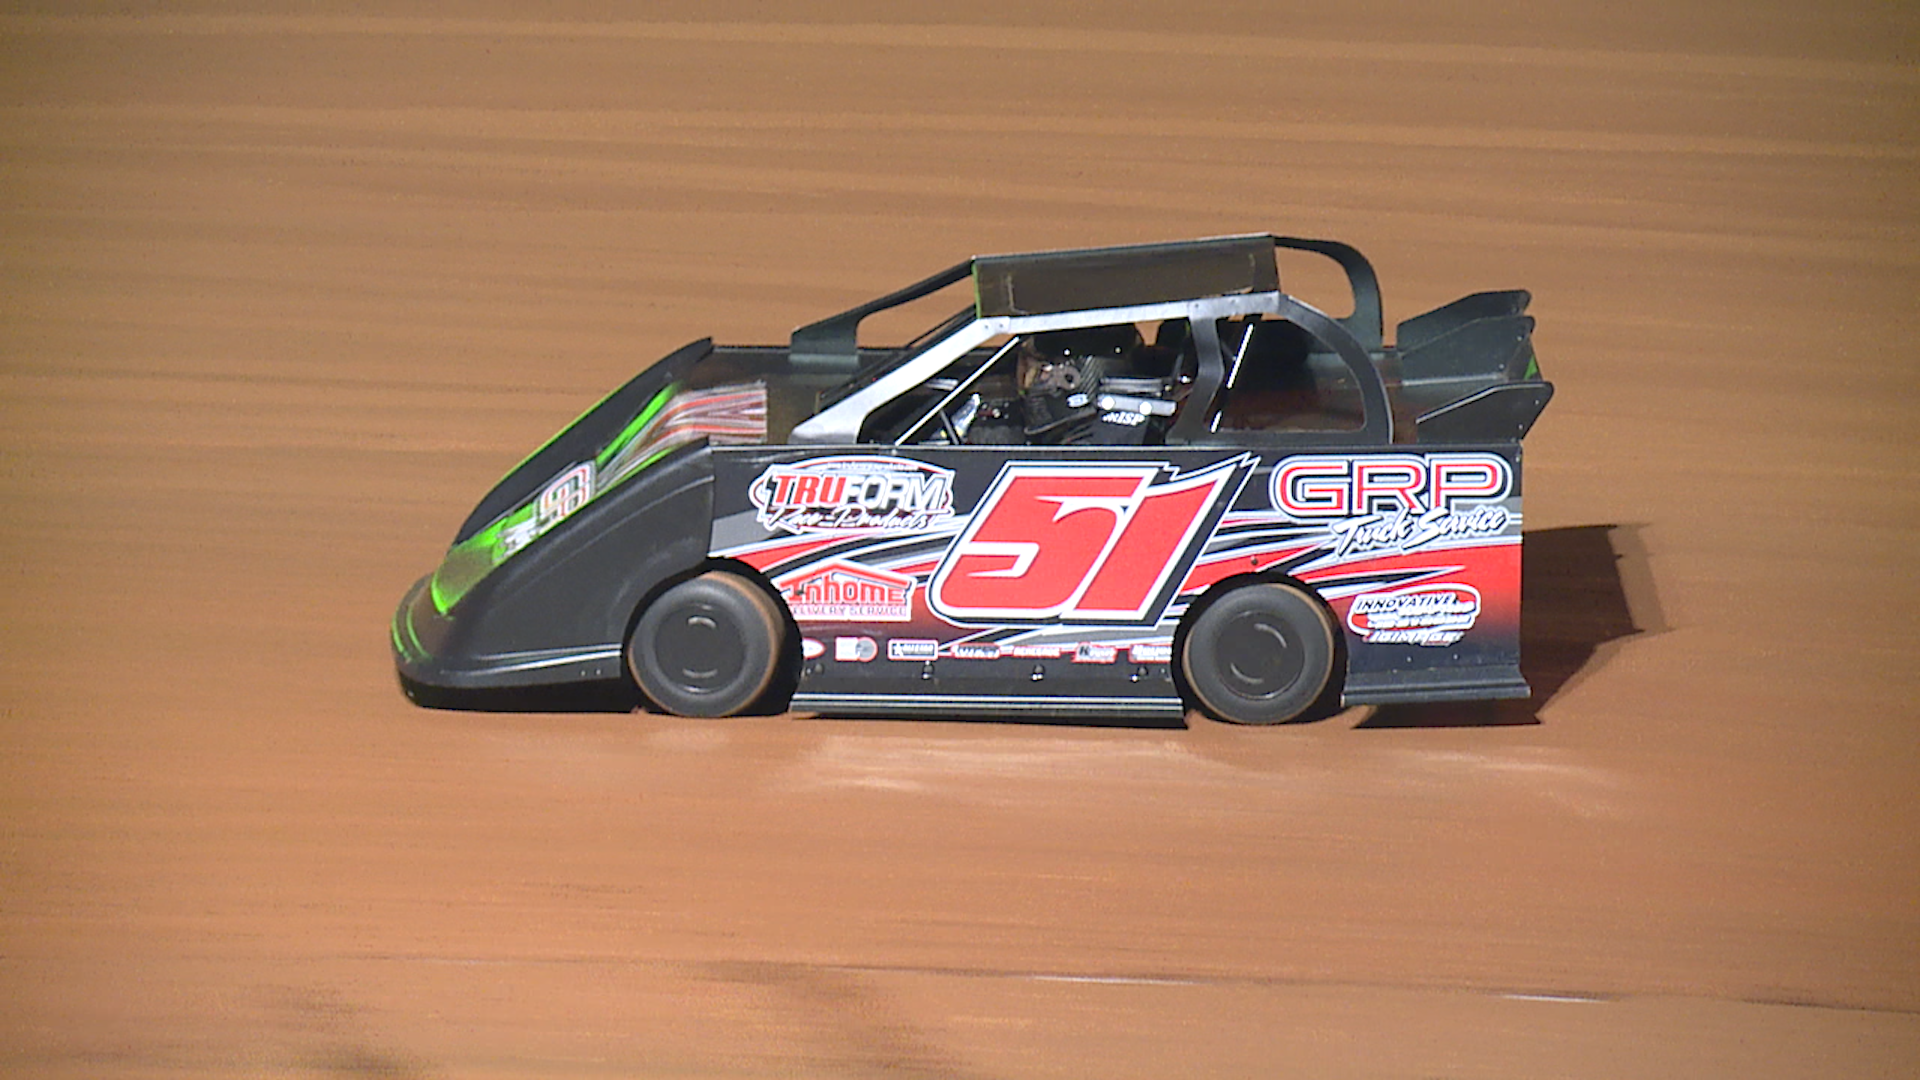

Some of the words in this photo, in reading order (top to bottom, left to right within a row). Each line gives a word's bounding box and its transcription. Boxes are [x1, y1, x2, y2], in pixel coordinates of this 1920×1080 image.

[773, 474, 948, 510] TRUFORM
[1273, 457, 1503, 517] GRP
[831, 504, 931, 529] Products
[1332, 507, 1414, 557] Truck
[1402, 506, 1506, 551] Service
[932, 463, 1240, 624] 51
[792, 605, 846, 617] ELIVERY
[848, 605, 907, 618] SERVICE
[1356, 593, 1458, 612] INNOVATIVE
